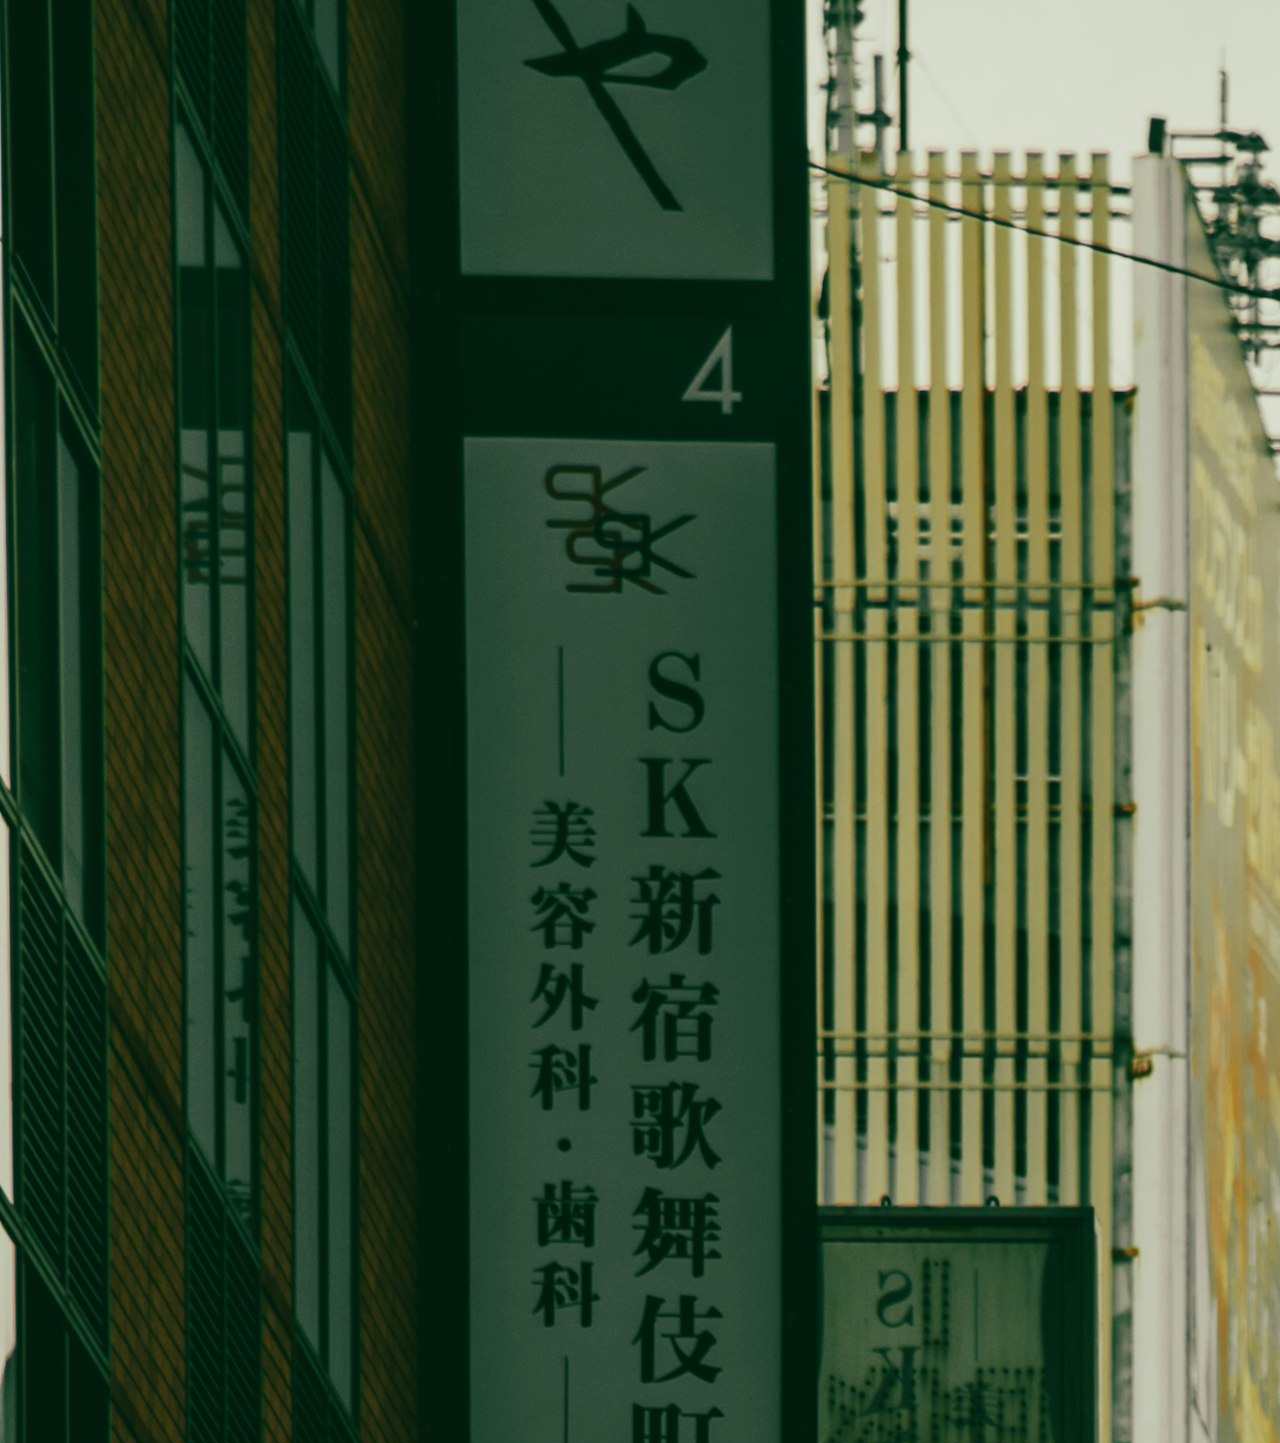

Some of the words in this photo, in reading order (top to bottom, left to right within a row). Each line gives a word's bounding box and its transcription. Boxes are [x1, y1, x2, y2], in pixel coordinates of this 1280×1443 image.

[681, 325, 742, 413] 4
[529, 800, 600, 1328] 美容外科・歯科
